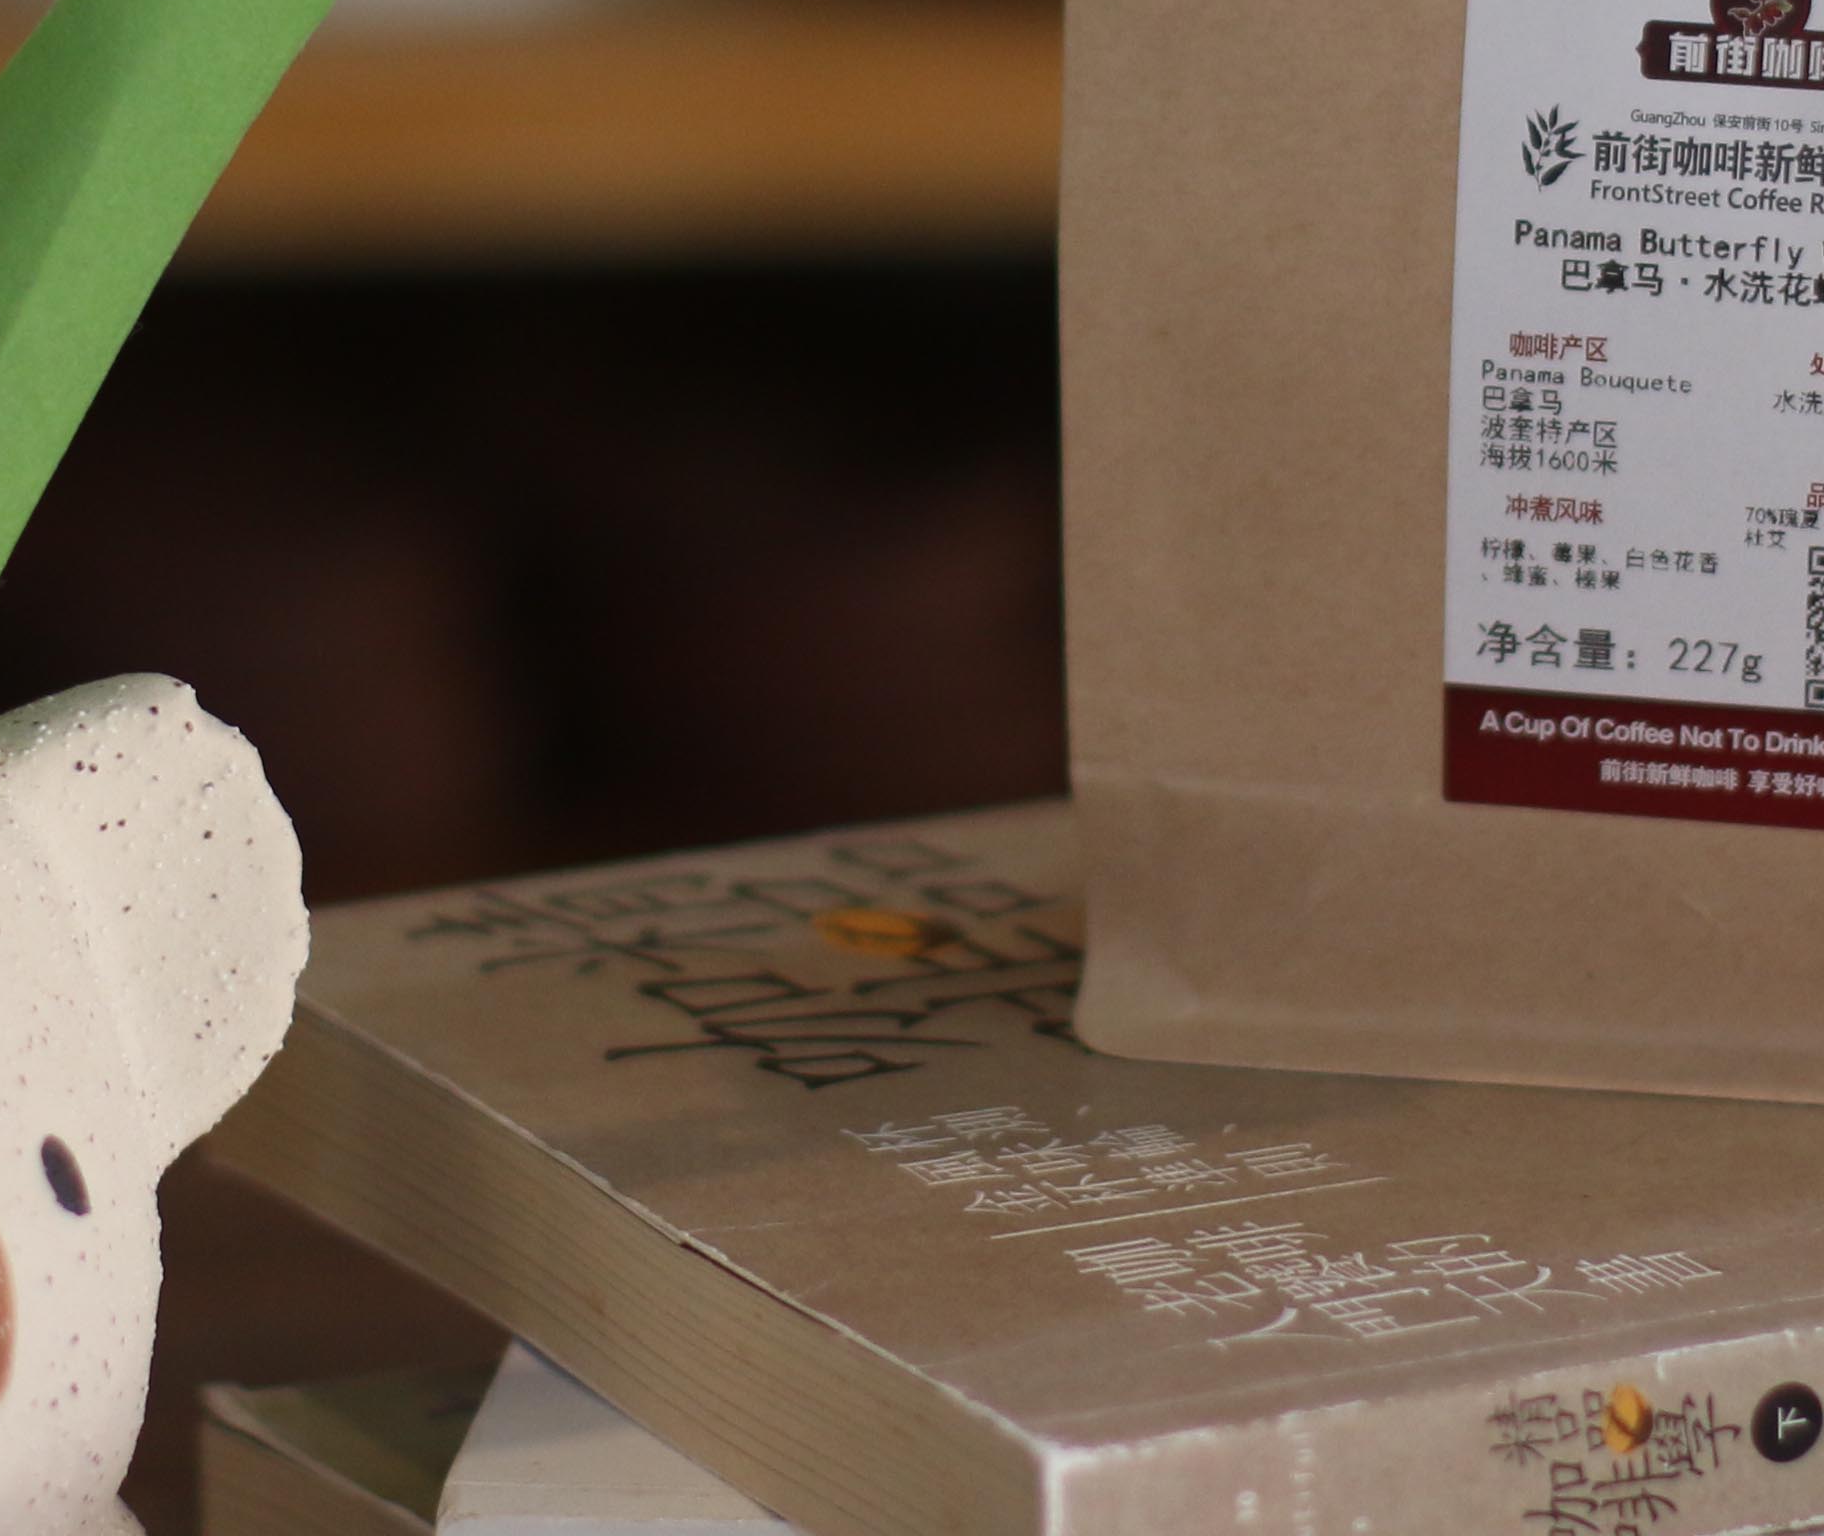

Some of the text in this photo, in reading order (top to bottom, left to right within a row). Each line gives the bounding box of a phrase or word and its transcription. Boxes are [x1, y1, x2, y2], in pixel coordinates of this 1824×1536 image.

[1630, 109, 1706, 128] GuangZhou
[1591, 180, 1720, 208] FrontStreet
[1727, 187, 1802, 213] Coffee
[1515, 220, 1622, 252] Panama
[1640, 228, 1804, 268] Butterfly
[1509, 331, 1608, 362] 咖啡产区
[1481, 360, 1692, 394] Panama Bouquete
[1483, 386, 1562, 415] 巴拿马
[1481, 415, 1618, 448] 波奎特产区
[1480, 442, 1618, 476] 海拔1600米
[1505, 493, 1604, 525] 冲煮风味
[1480, 711, 1500, 733] A
[1505, 711, 1554, 740] Cup
[1561, 716, 1591, 739] Of
[1594, 718, 1674, 747] Coffee
[1680, 725, 1724, 750] Not
[1727, 728, 1761, 753] To
[1599, 758, 1739, 792] 前街新鲜咖啡
